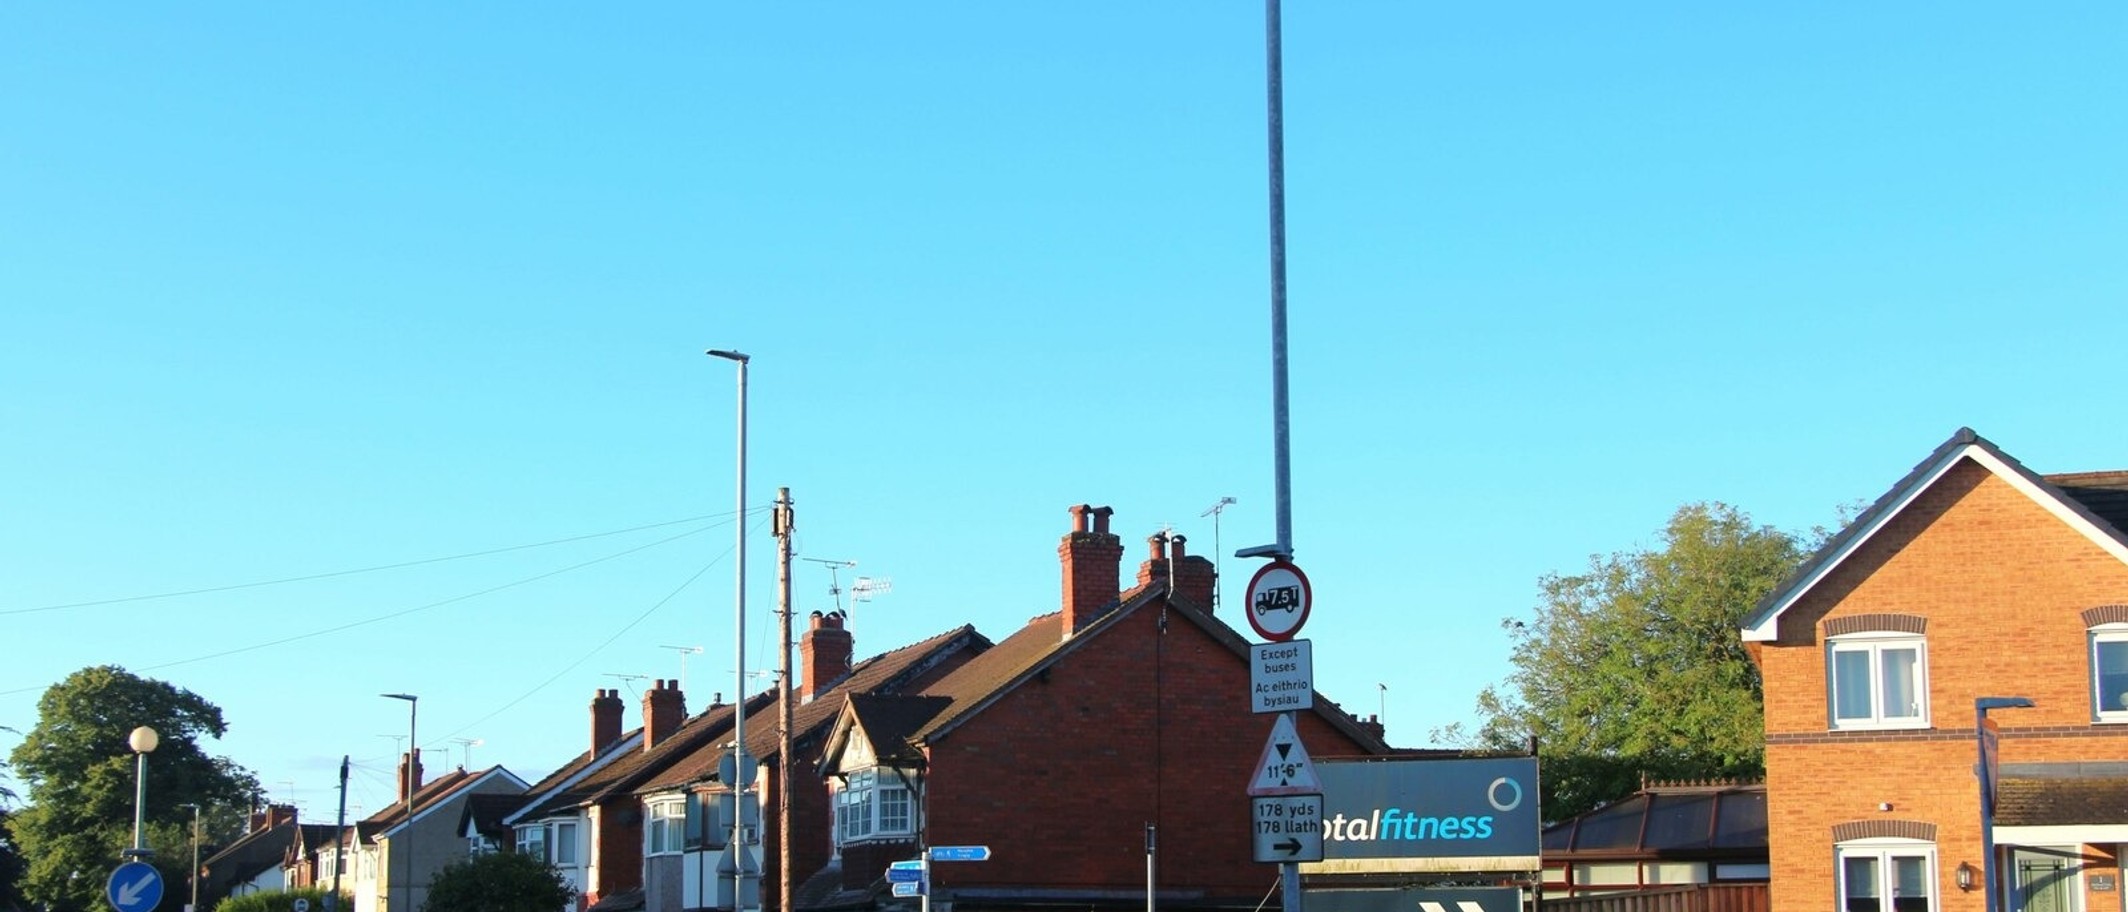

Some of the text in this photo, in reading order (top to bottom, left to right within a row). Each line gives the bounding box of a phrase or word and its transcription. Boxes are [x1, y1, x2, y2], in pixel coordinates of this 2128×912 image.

[1260, 647, 1298, 661] Except
[1264, 662, 1297, 674] buses
[1255, 680, 1308, 694] Ac eithrio
[1263, 694, 1300, 707] bysiau
[1259, 802, 1314, 818] 178 yds
[1257, 819, 1318, 834] 178 llath
[1323, 808, 1493, 842] talfitness
